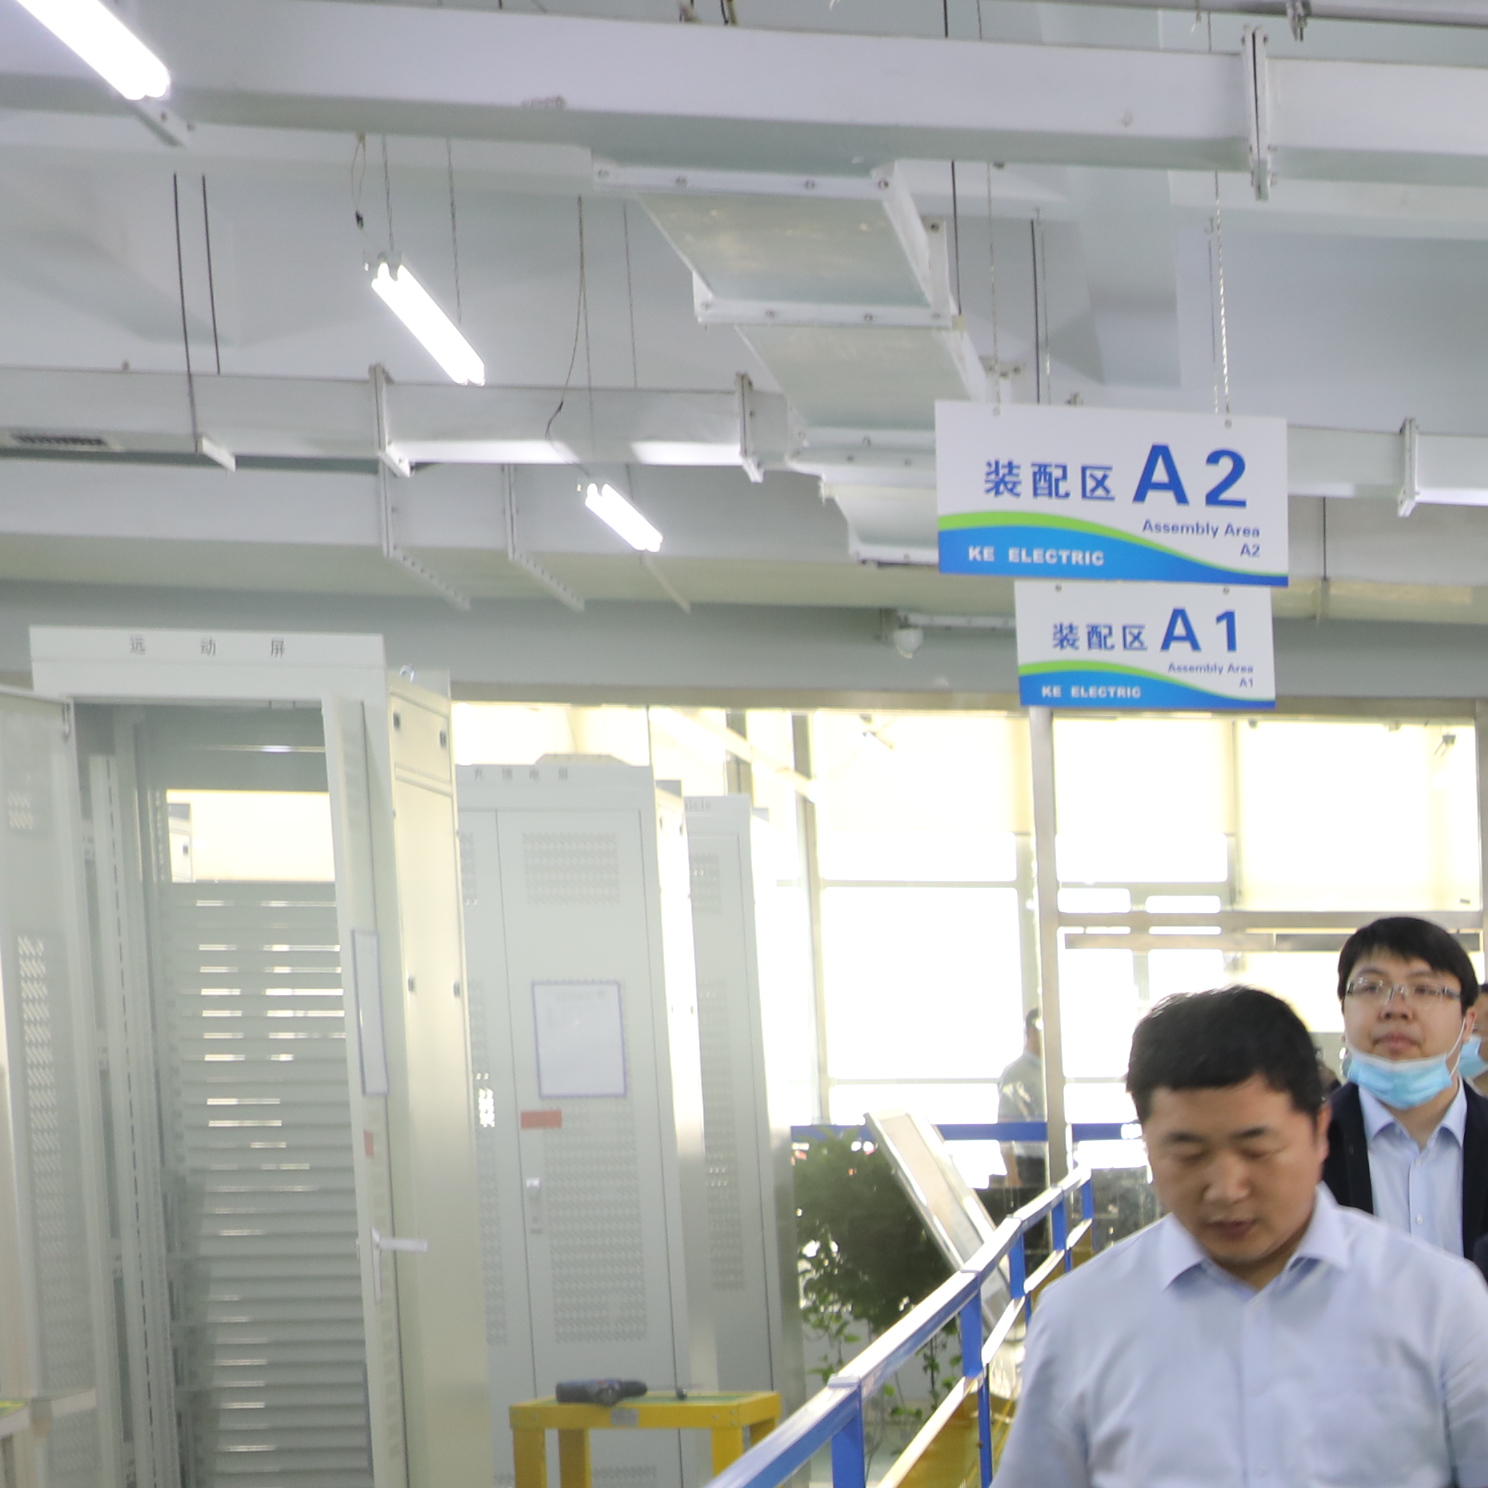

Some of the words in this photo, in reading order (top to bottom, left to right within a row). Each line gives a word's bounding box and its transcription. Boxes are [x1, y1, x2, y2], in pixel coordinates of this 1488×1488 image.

[984, 459, 1116, 502] 装配区
[1131, 442, 1248, 509] A2
[1142, 519, 1220, 539] Assembly
[1223, 522, 1261, 539] Area
[967, 545, 996, 563] KE
[1007, 547, 1105, 567] ELECTRIC
[1239, 543, 1261, 559] A2
[1051, 622, 1148, 653] 装配区
[1159, 606, 1238, 654] A1
[1167, 661, 1224, 675] Assembly
[1227, 663, 1254, 675] Area
[1041, 685, 1062, 698] KE
[1070, 686, 1142, 699] ELECTRIC
[1239, 677, 1255, 689] A1
